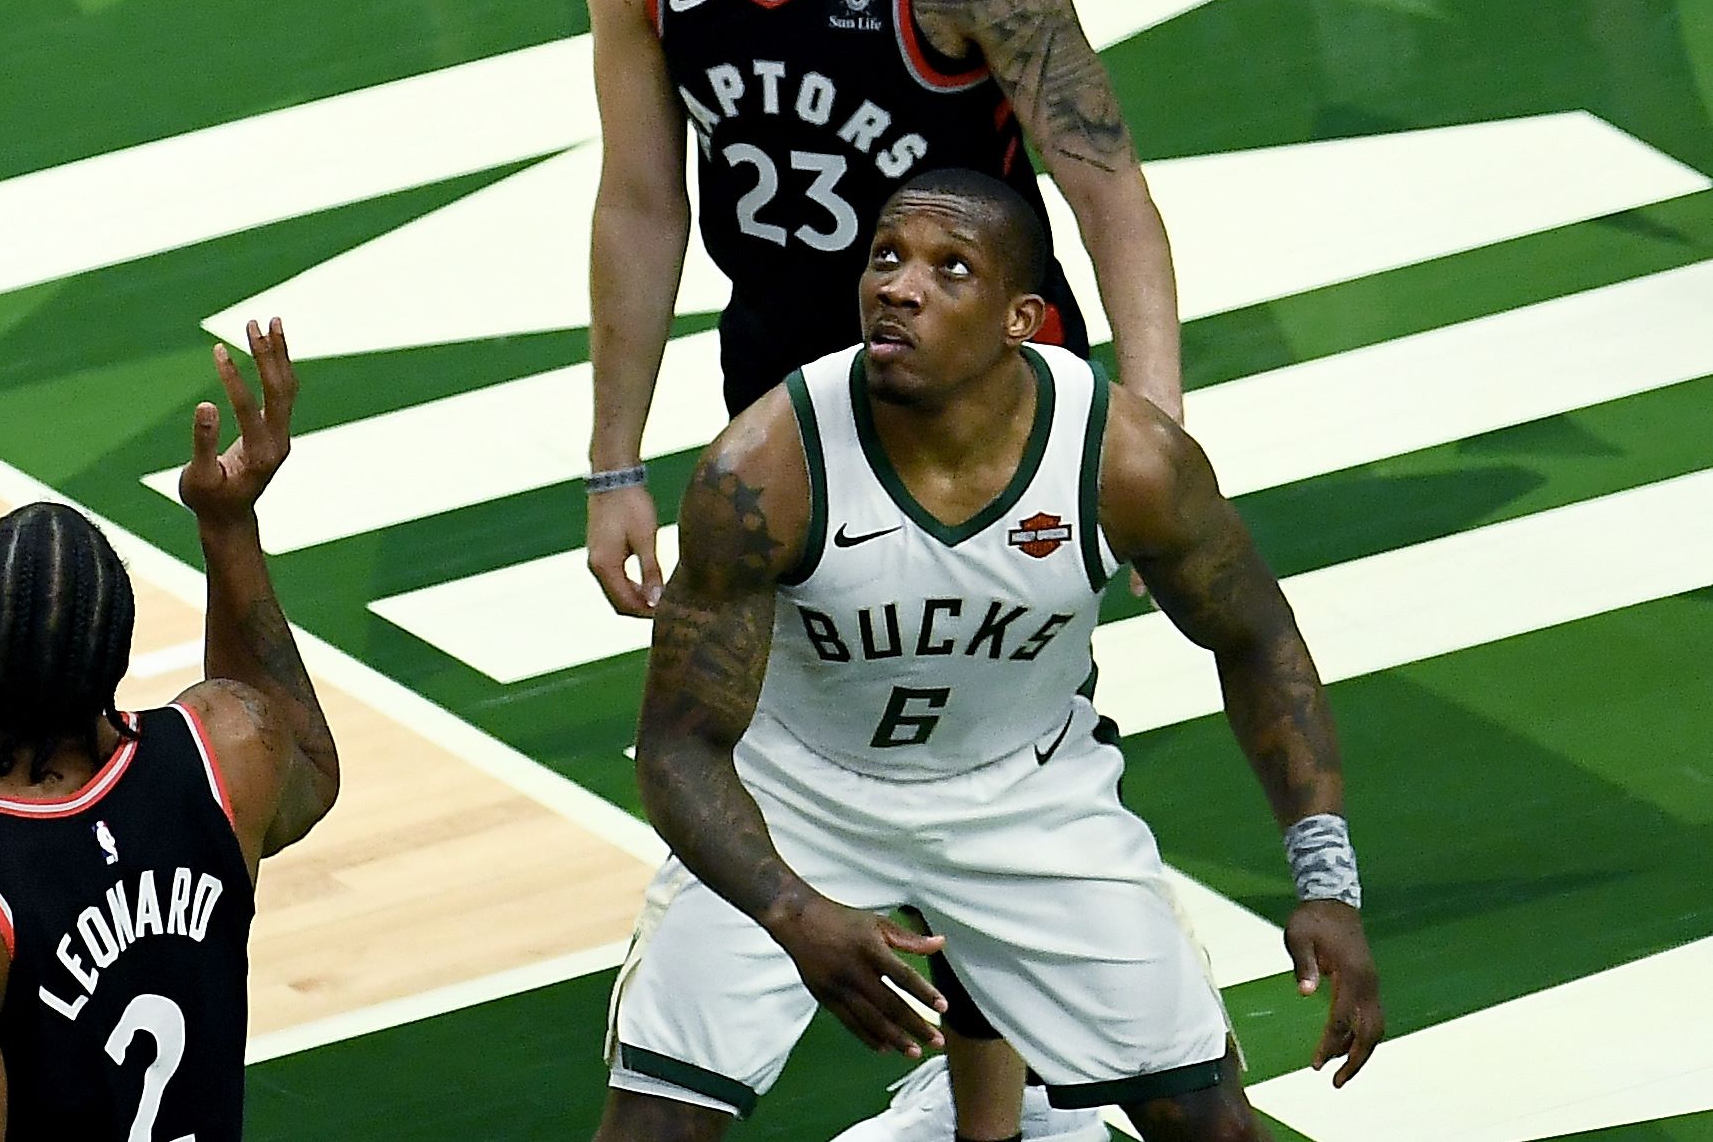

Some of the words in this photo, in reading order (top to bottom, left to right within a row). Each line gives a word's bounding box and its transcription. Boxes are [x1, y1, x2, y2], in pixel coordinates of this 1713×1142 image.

[722, 142, 859, 252] 23
[797, 598, 1076, 663] BUCKS
[869, 685, 951, 748] 6
[38, 866, 224, 1022] LEONARD
[104, 993, 196, 1142] 2
